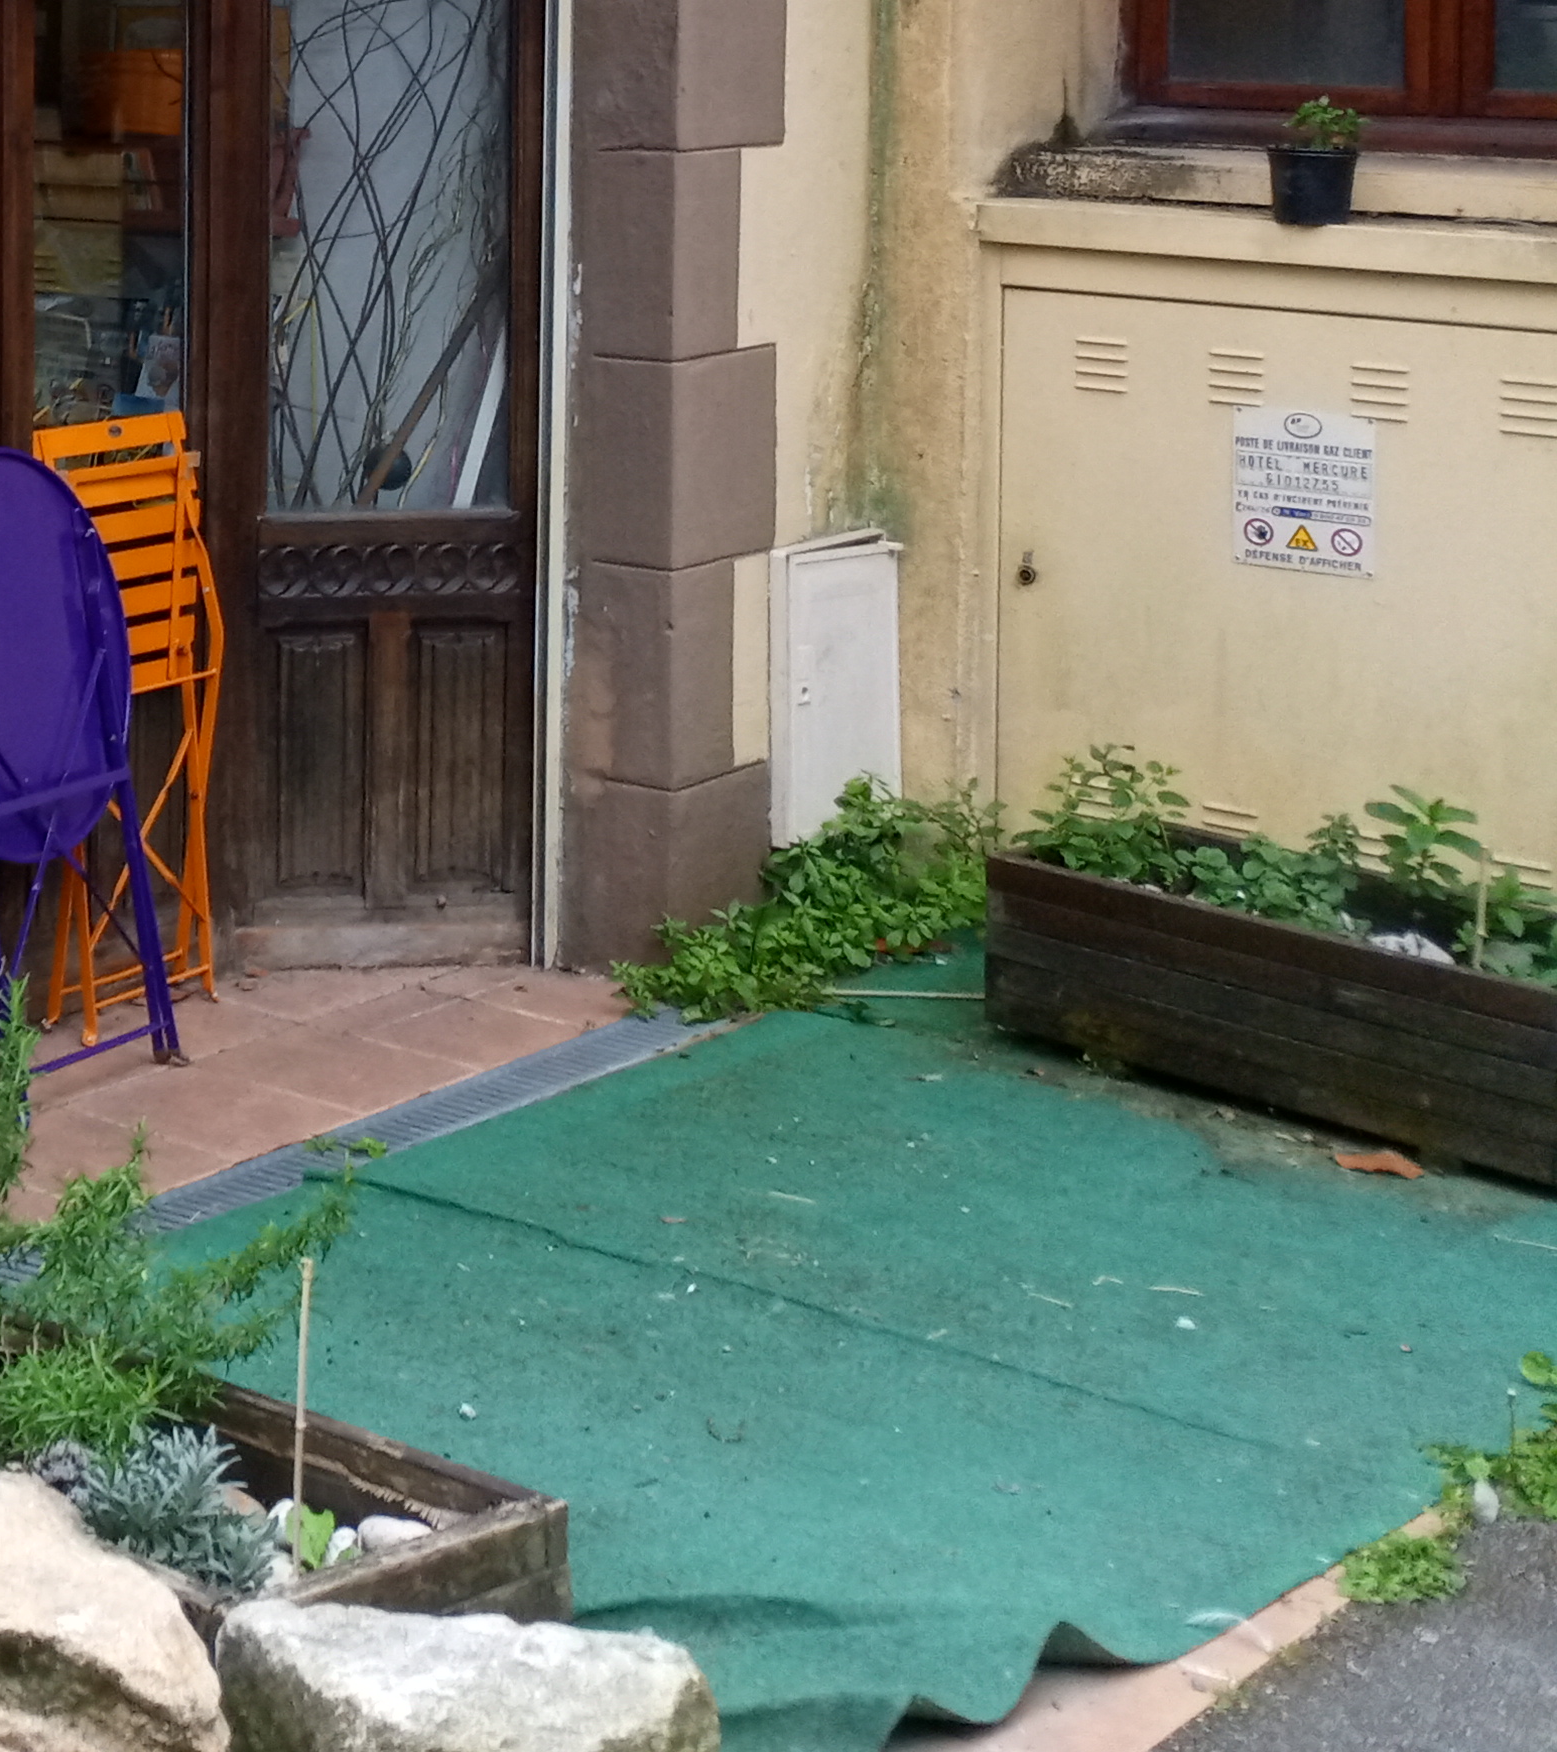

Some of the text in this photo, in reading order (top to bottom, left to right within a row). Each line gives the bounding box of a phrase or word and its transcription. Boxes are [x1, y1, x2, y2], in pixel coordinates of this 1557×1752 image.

[1235, 436, 1259, 448] POSTE
[1263, 439, 1273, 450] DE
[1277, 440, 1319, 454] LIVRAISON
[1343, 447, 1372, 459] CLIENT
[1239, 454, 1368, 480] HOTEL MERCURE
[1245, 549, 1361, 571] DÉFENSE D'AFFICHER
